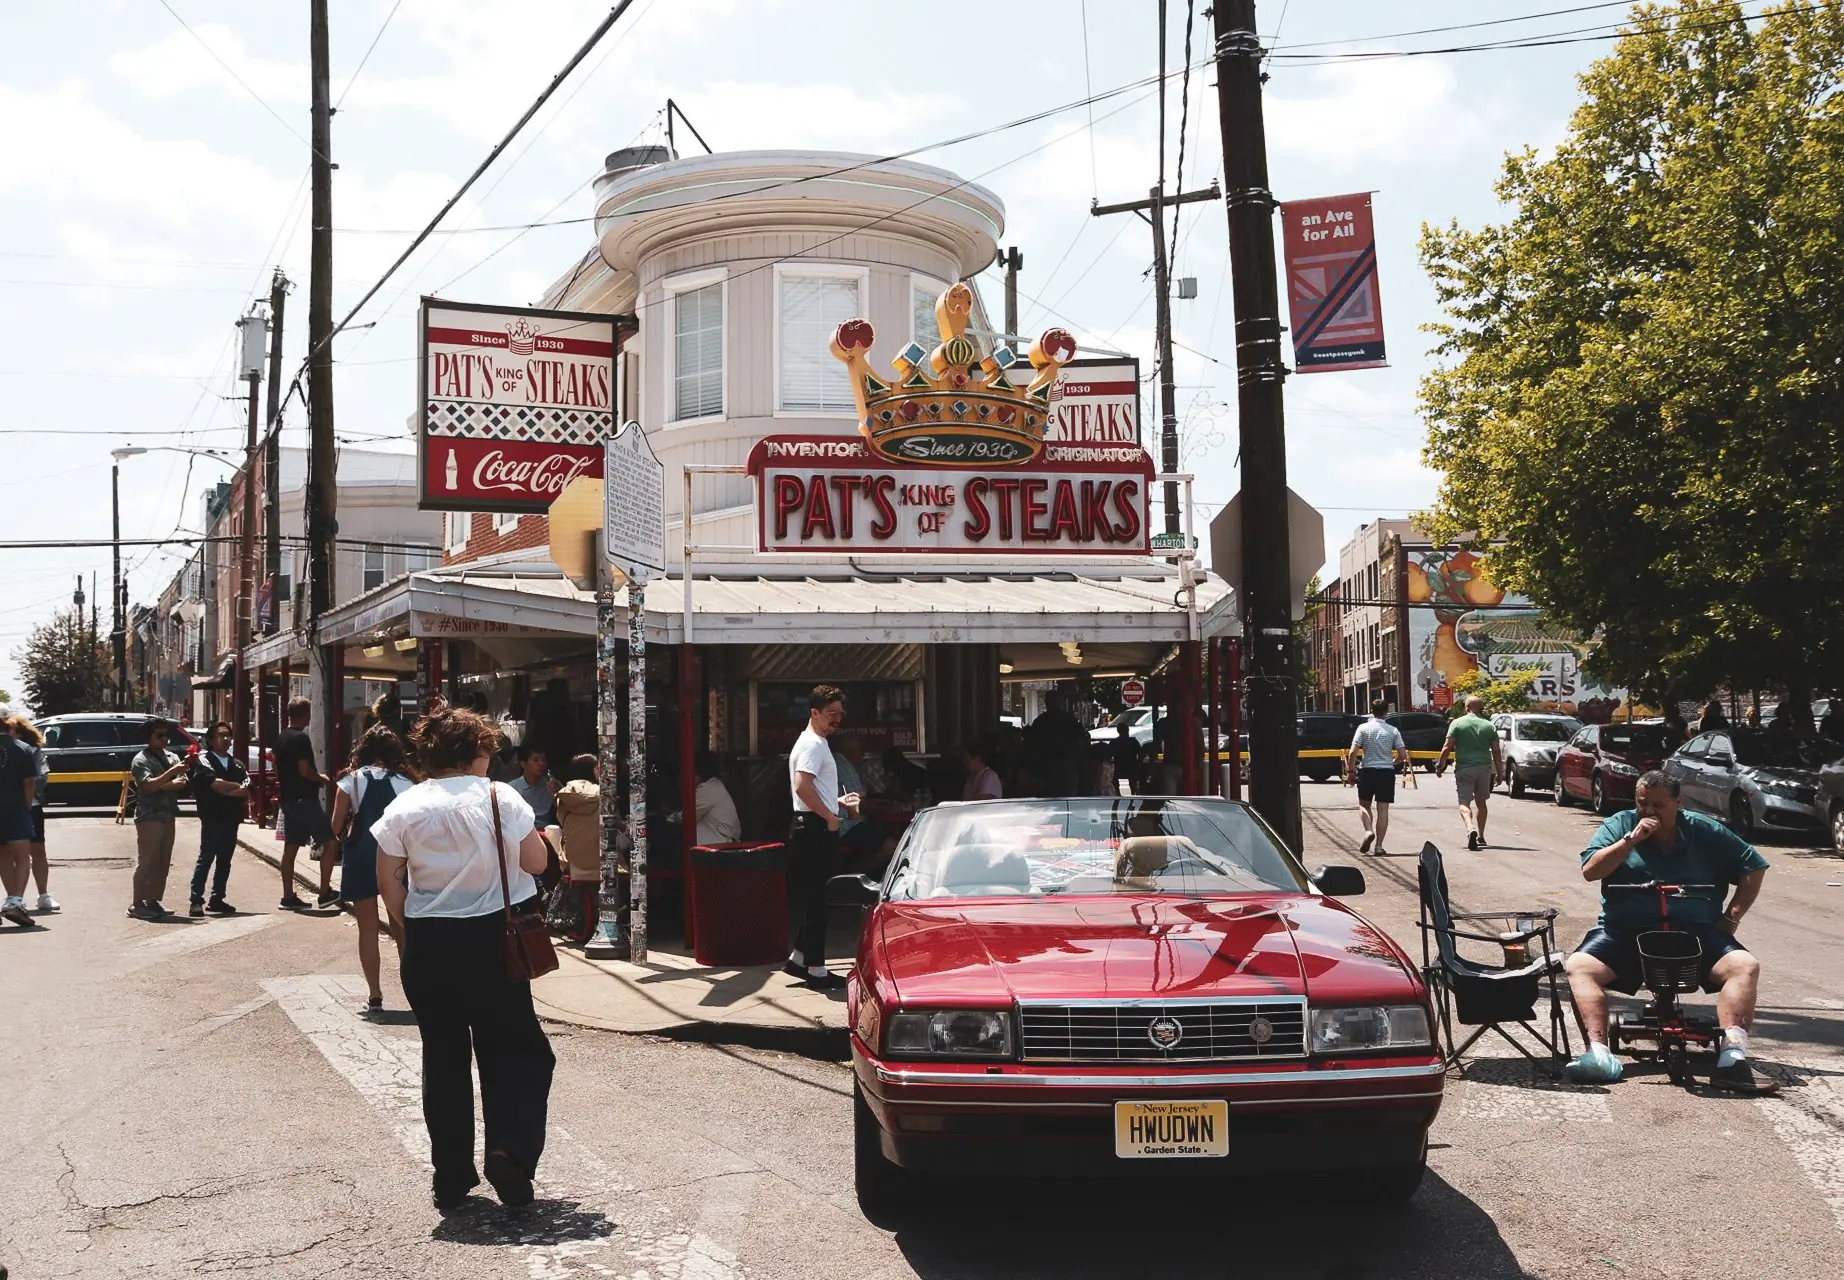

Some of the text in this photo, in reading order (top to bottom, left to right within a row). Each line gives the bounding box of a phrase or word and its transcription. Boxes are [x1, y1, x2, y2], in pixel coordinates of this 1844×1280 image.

[1302, 210, 1354, 226] an Ave
[1303, 223, 1355, 242] for All
[471, 334, 564, 349] Since 1930
[434, 352, 609, 409] PAT'S KING STEAKS
[502, 381, 518, 392] OF
[1066, 386, 1091, 394] 1930
[1058, 402, 1133, 441] STEAKS
[765, 441, 1145, 463] INVENTOR ORIGINATOR
[900, 436, 1014, 459] Since 1930
[472, 450, 597, 493] Coca-Col
[773, 474, 1141, 544] PAT'S KING STEAKS
[917, 511, 947, 534] OF
[438, 616, 480, 633] #Since
[857, 727, 868, 735] TO
[869, 727, 887, 736] YOU
[1142, 1103, 1200, 1115] New Jersey
[1129, 1115, 1214, 1143] HWUDWN
[1143, 1145, 1202, 1155] Garden State
